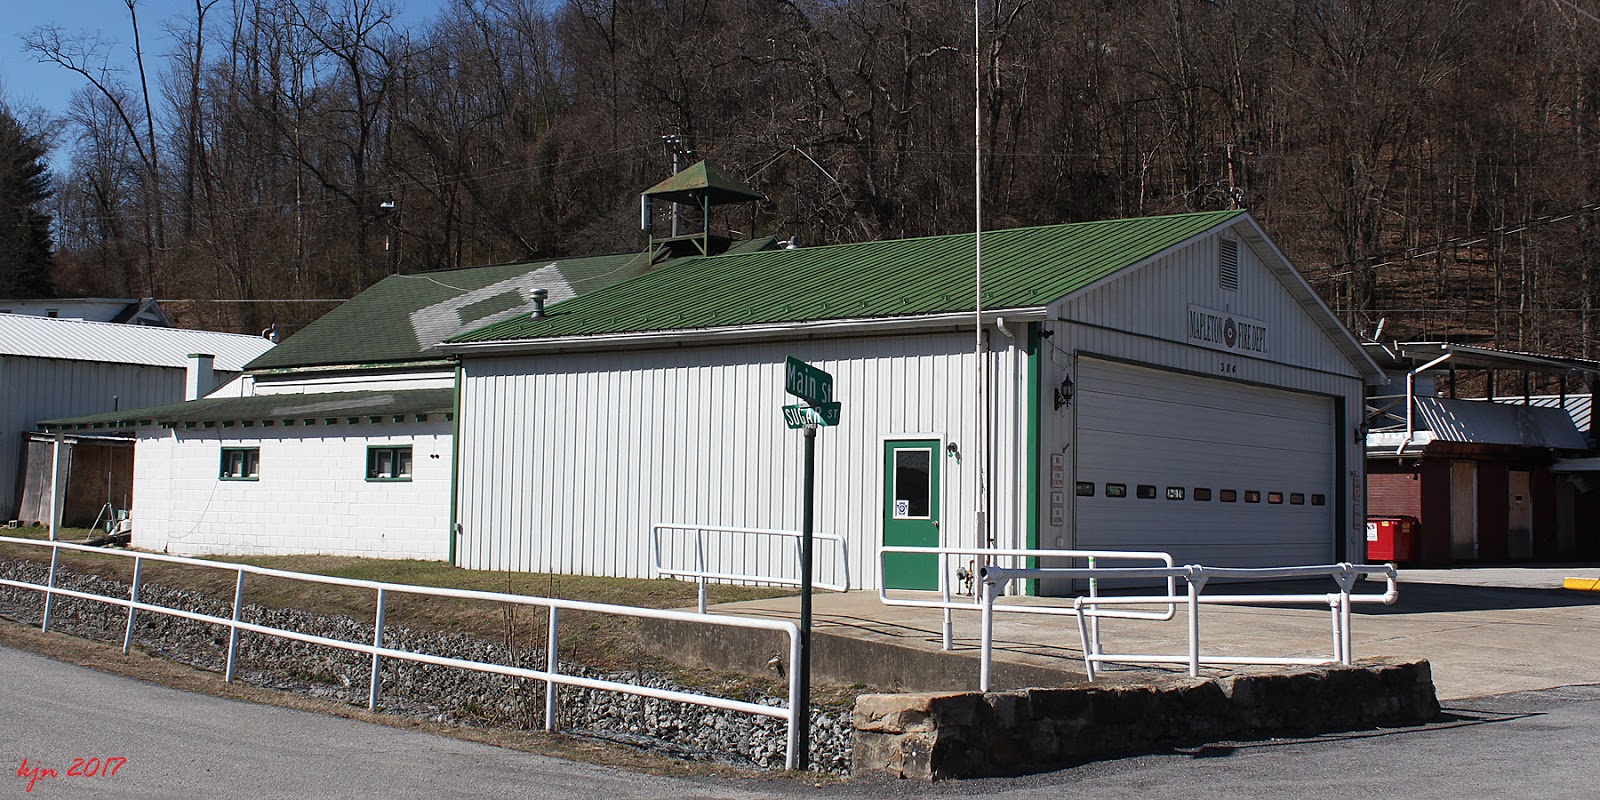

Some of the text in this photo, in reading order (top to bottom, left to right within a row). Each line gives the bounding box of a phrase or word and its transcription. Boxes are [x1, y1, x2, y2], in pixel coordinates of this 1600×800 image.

[1190, 310, 1223, 344] MAPLETON
[1238, 322, 1251, 350] FIRE
[786, 362, 832, 403] Main St
[784, 406, 838, 426] SUGAR ST
